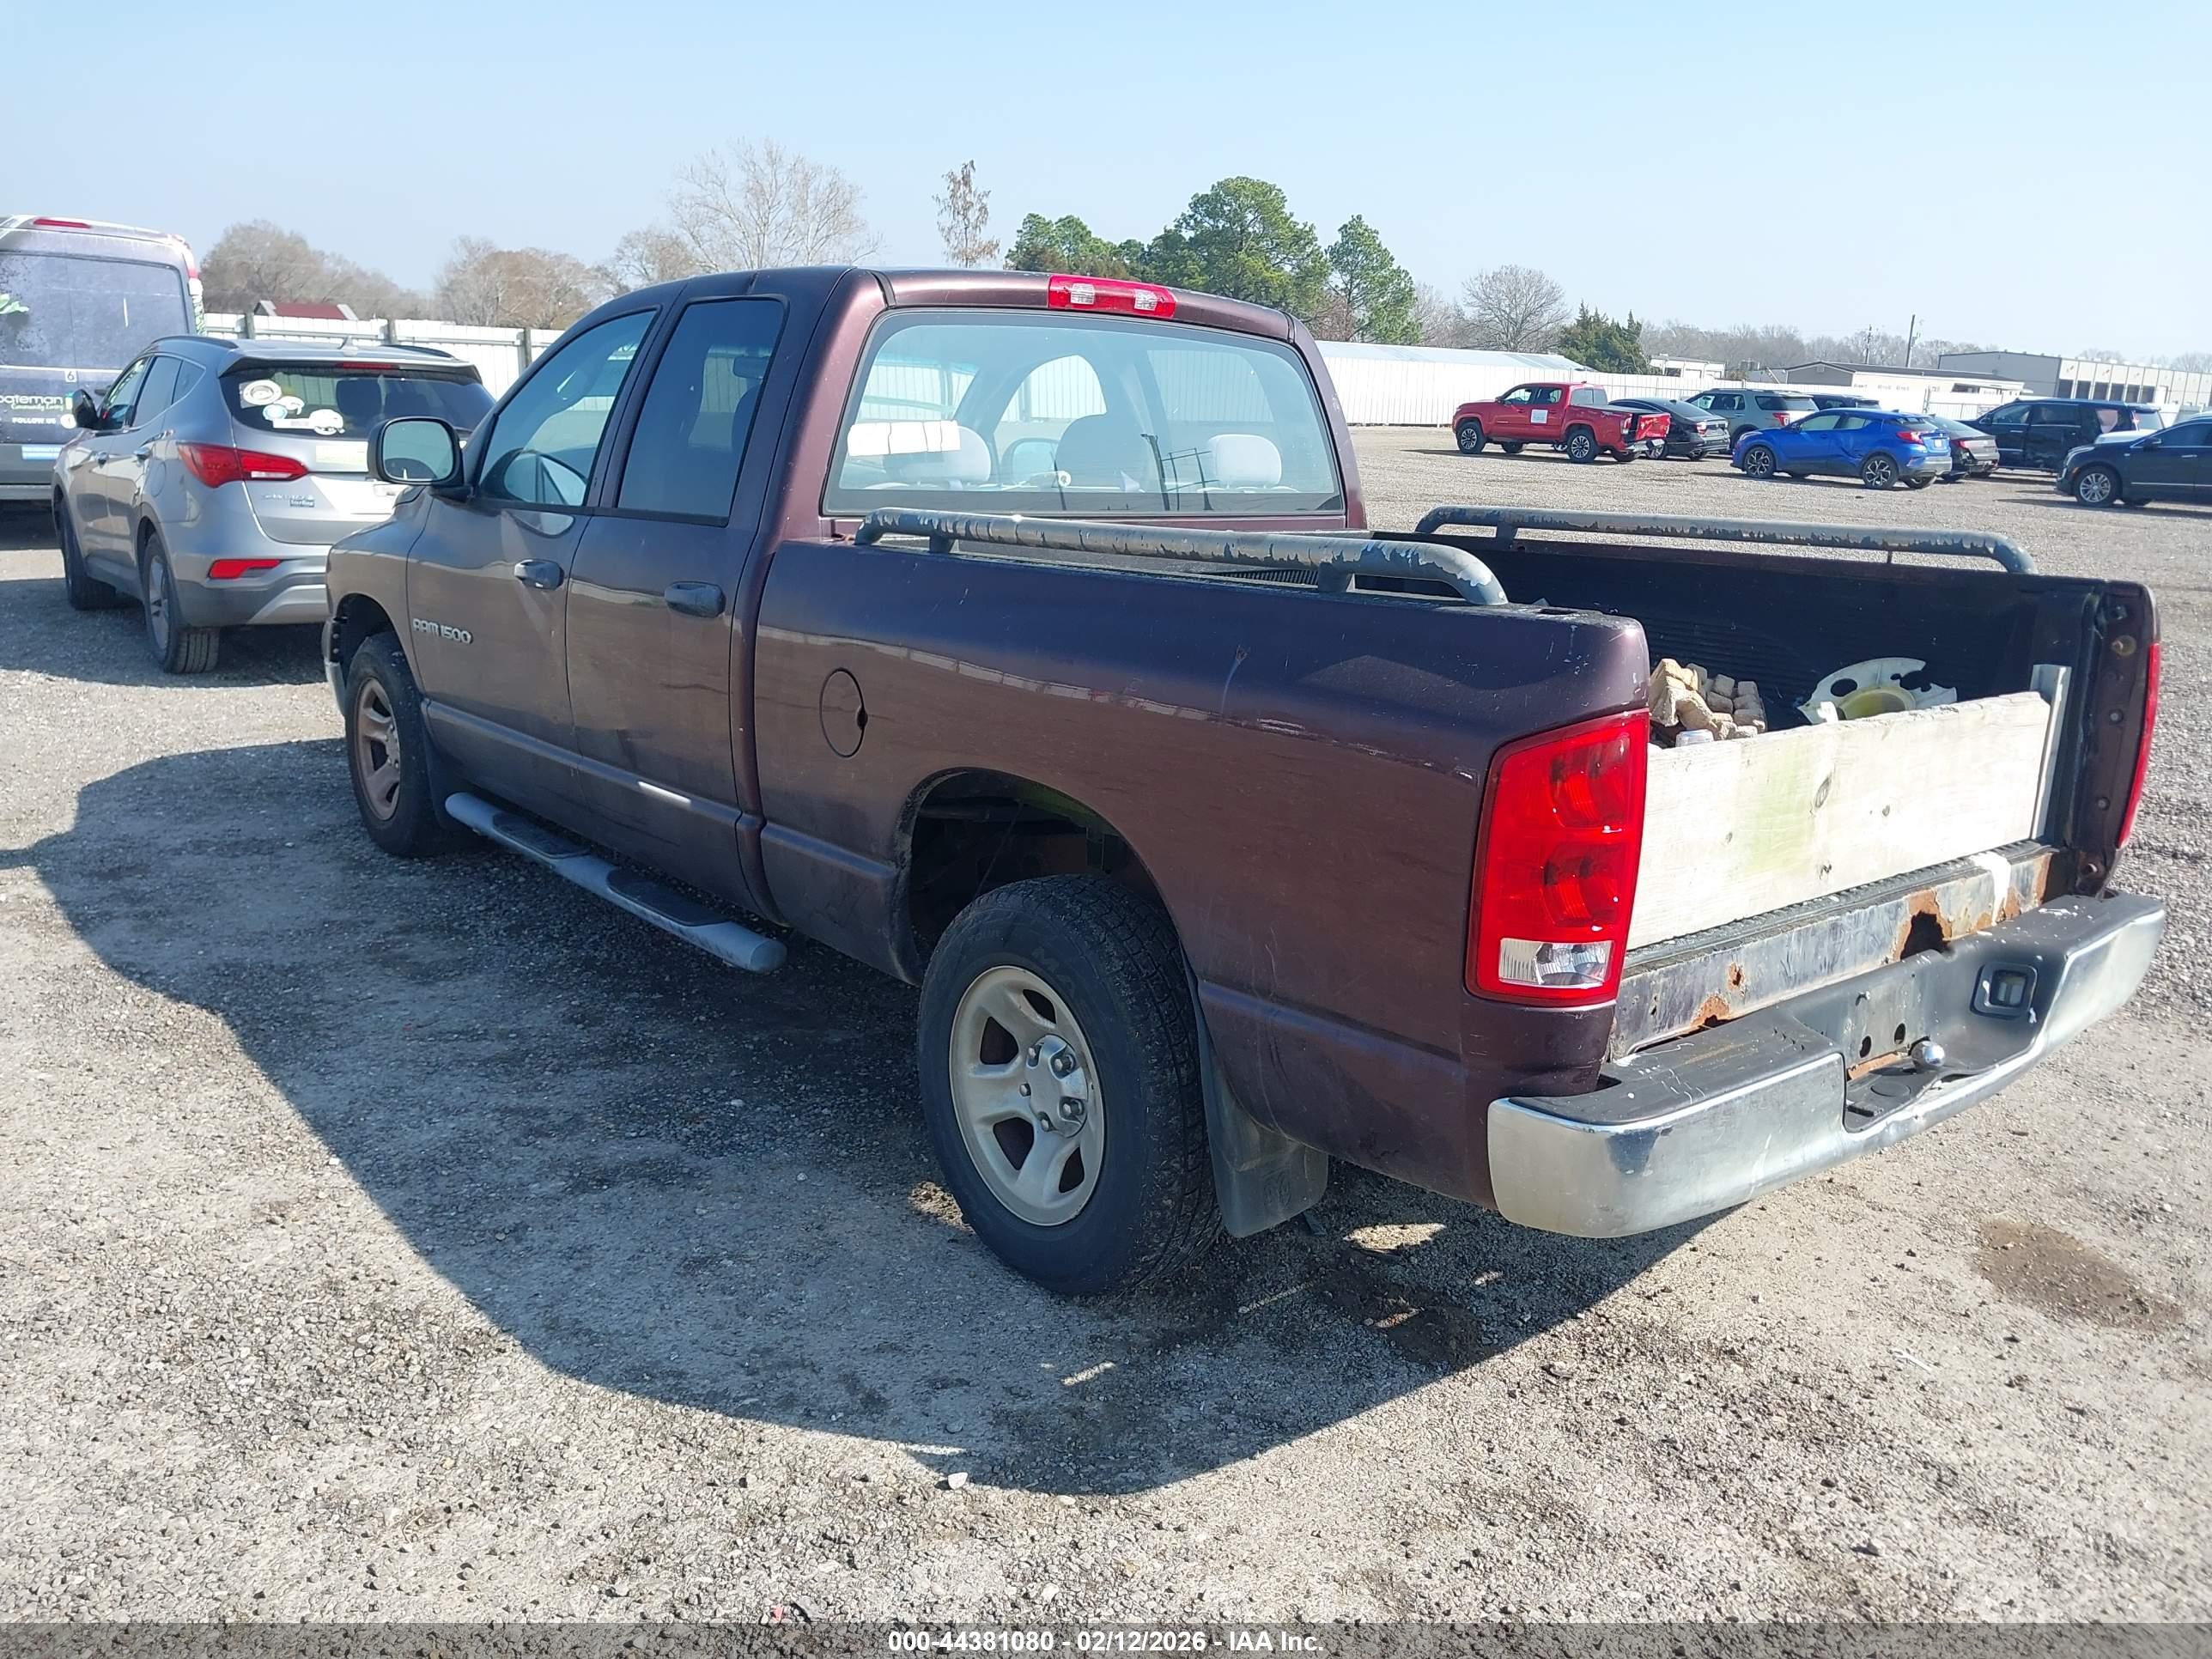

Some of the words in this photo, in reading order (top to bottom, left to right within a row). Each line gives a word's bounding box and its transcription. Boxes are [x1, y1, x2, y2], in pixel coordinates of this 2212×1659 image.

[67, 371, 75, 381] 6
[413, 618, 439, 636] RAM
[441, 625, 471, 643] 1500
